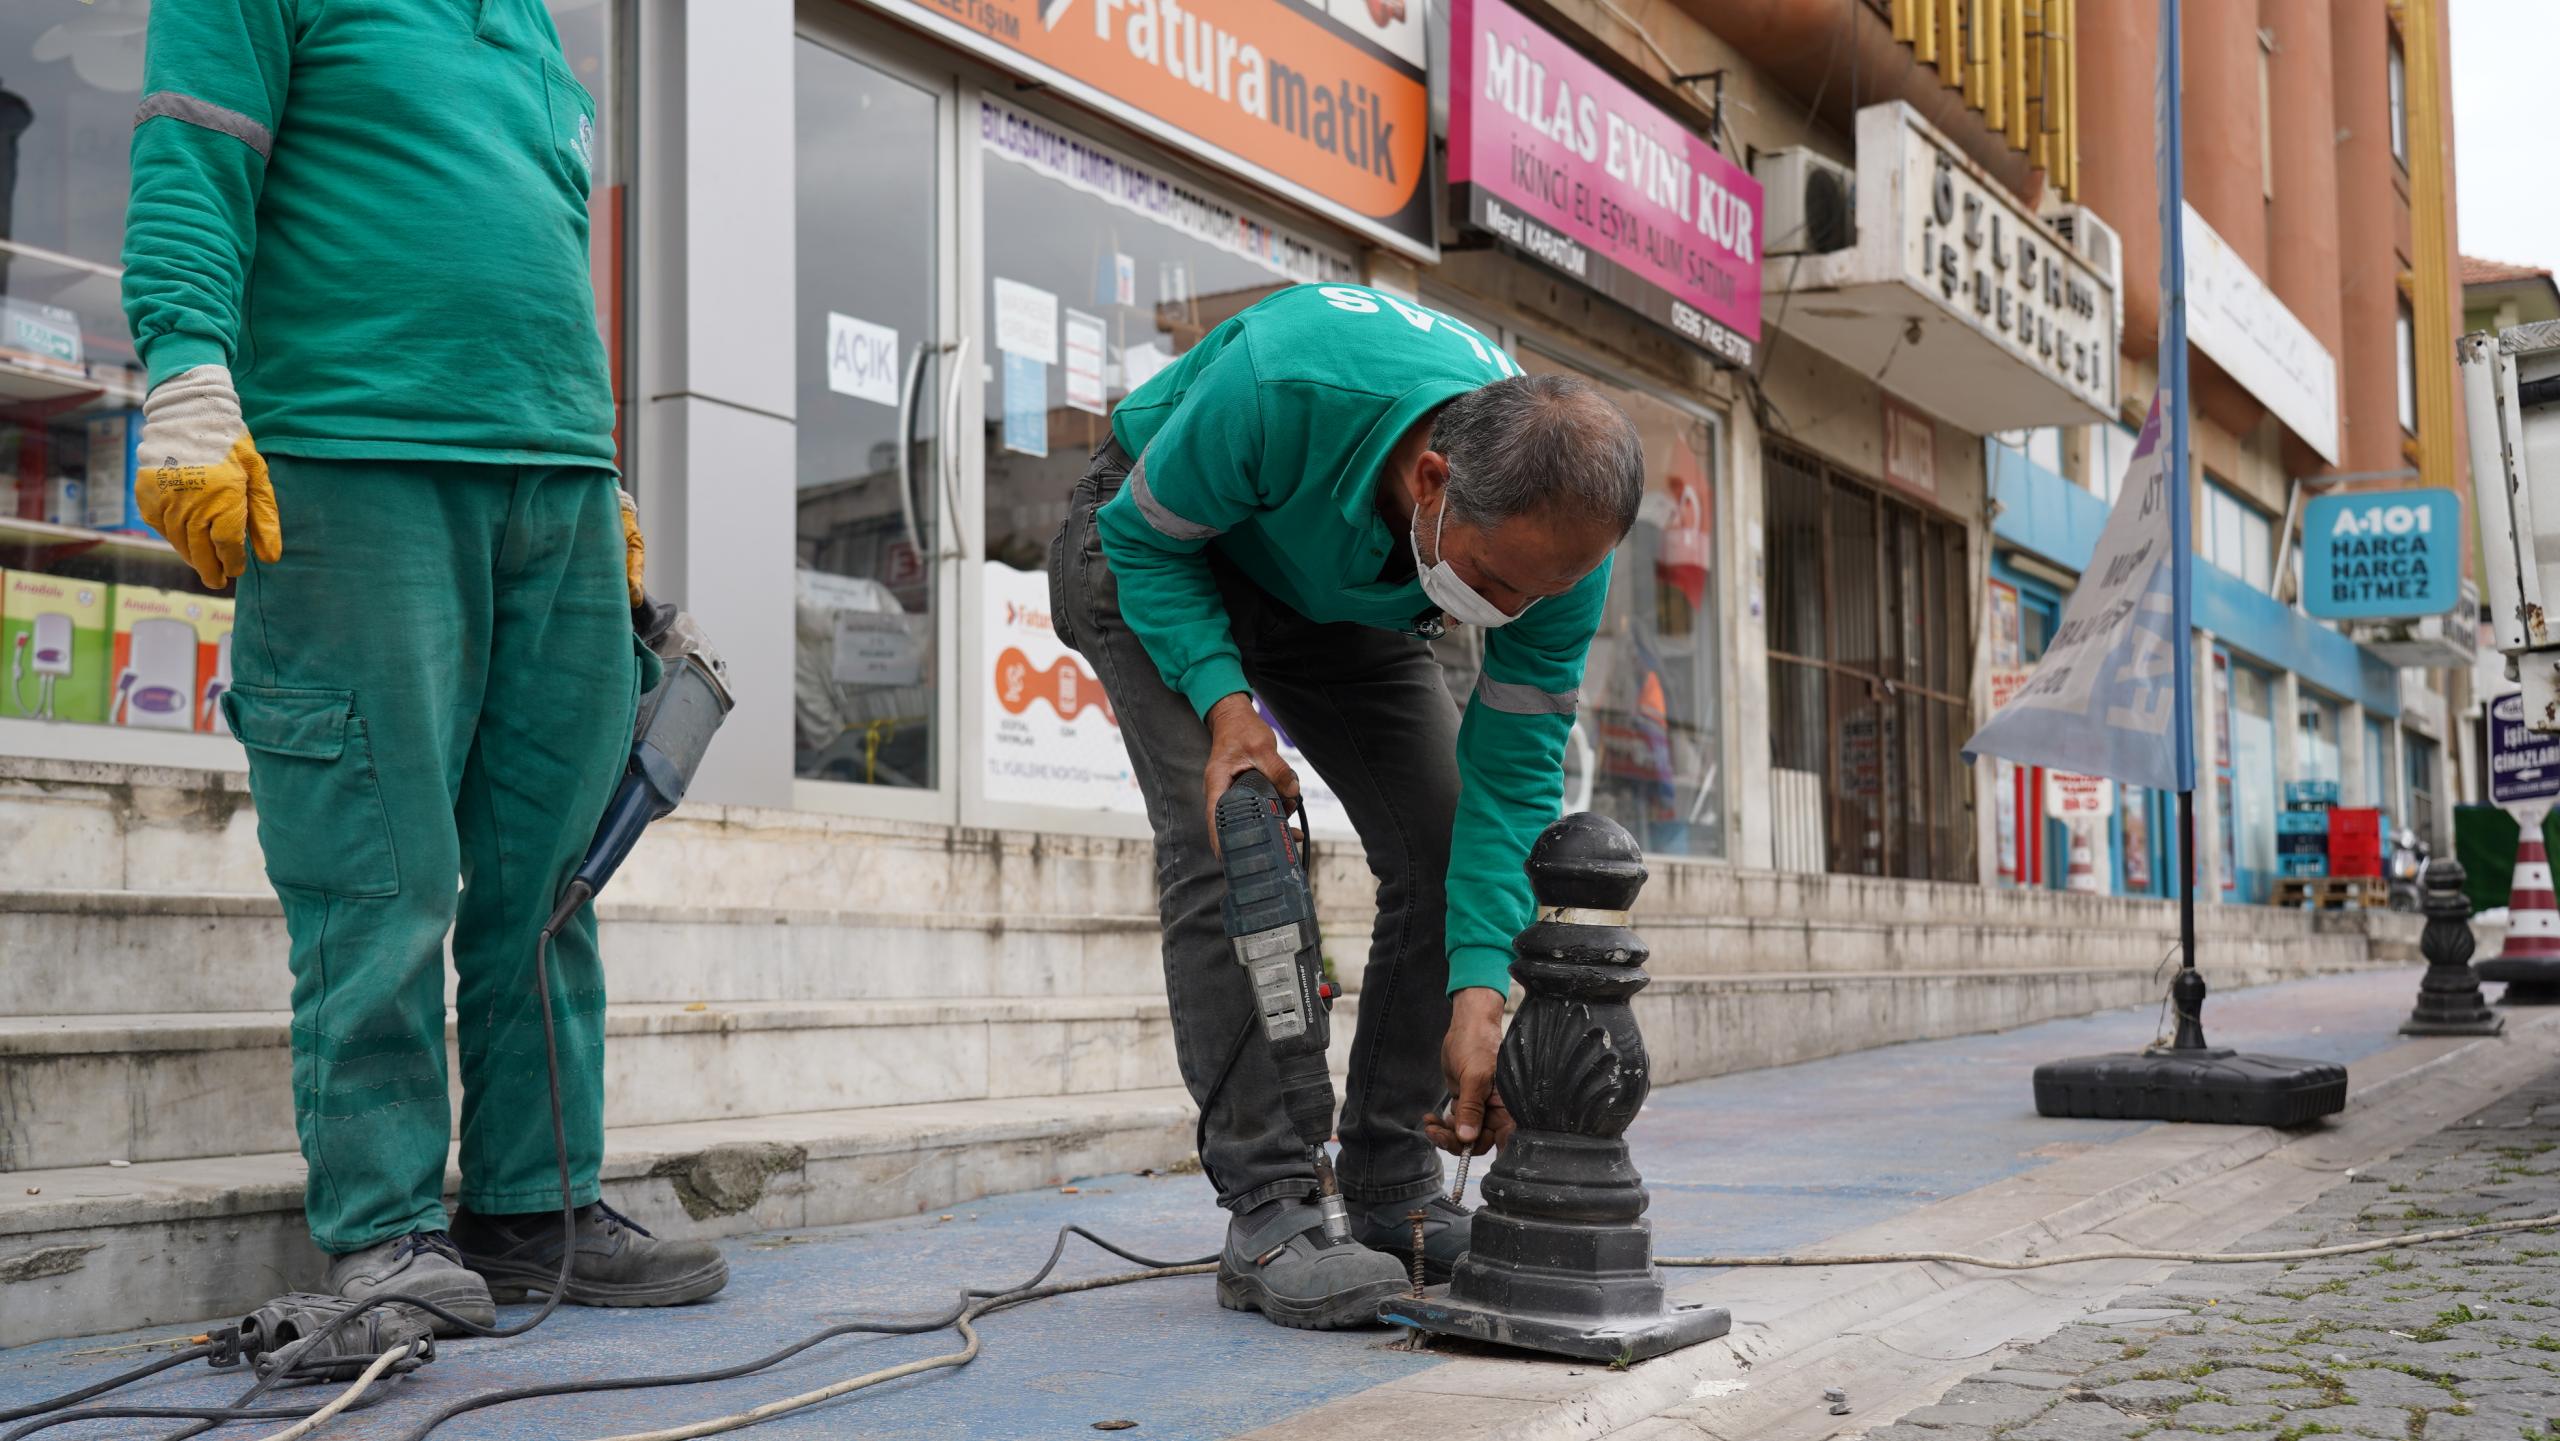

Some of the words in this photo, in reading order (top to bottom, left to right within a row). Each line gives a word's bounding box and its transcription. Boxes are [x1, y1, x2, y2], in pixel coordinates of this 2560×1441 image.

[1485, 31, 1600, 163] MİLAS
[1604, 111, 1692, 224] EVİNİ
[1697, 173, 1754, 265] KUR
[1510, 133, 1569, 212] İKİNCİ
[1575, 182, 1594, 229] EL
[1932, 148, 2063, 311] ÖZLER
[833, 328, 893, 387] AÇIK
[2332, 536, 2428, 558] HARCA
[2332, 559, 2428, 579] HARCA
[1299, 963, 1314, 1024] Boschhammer
